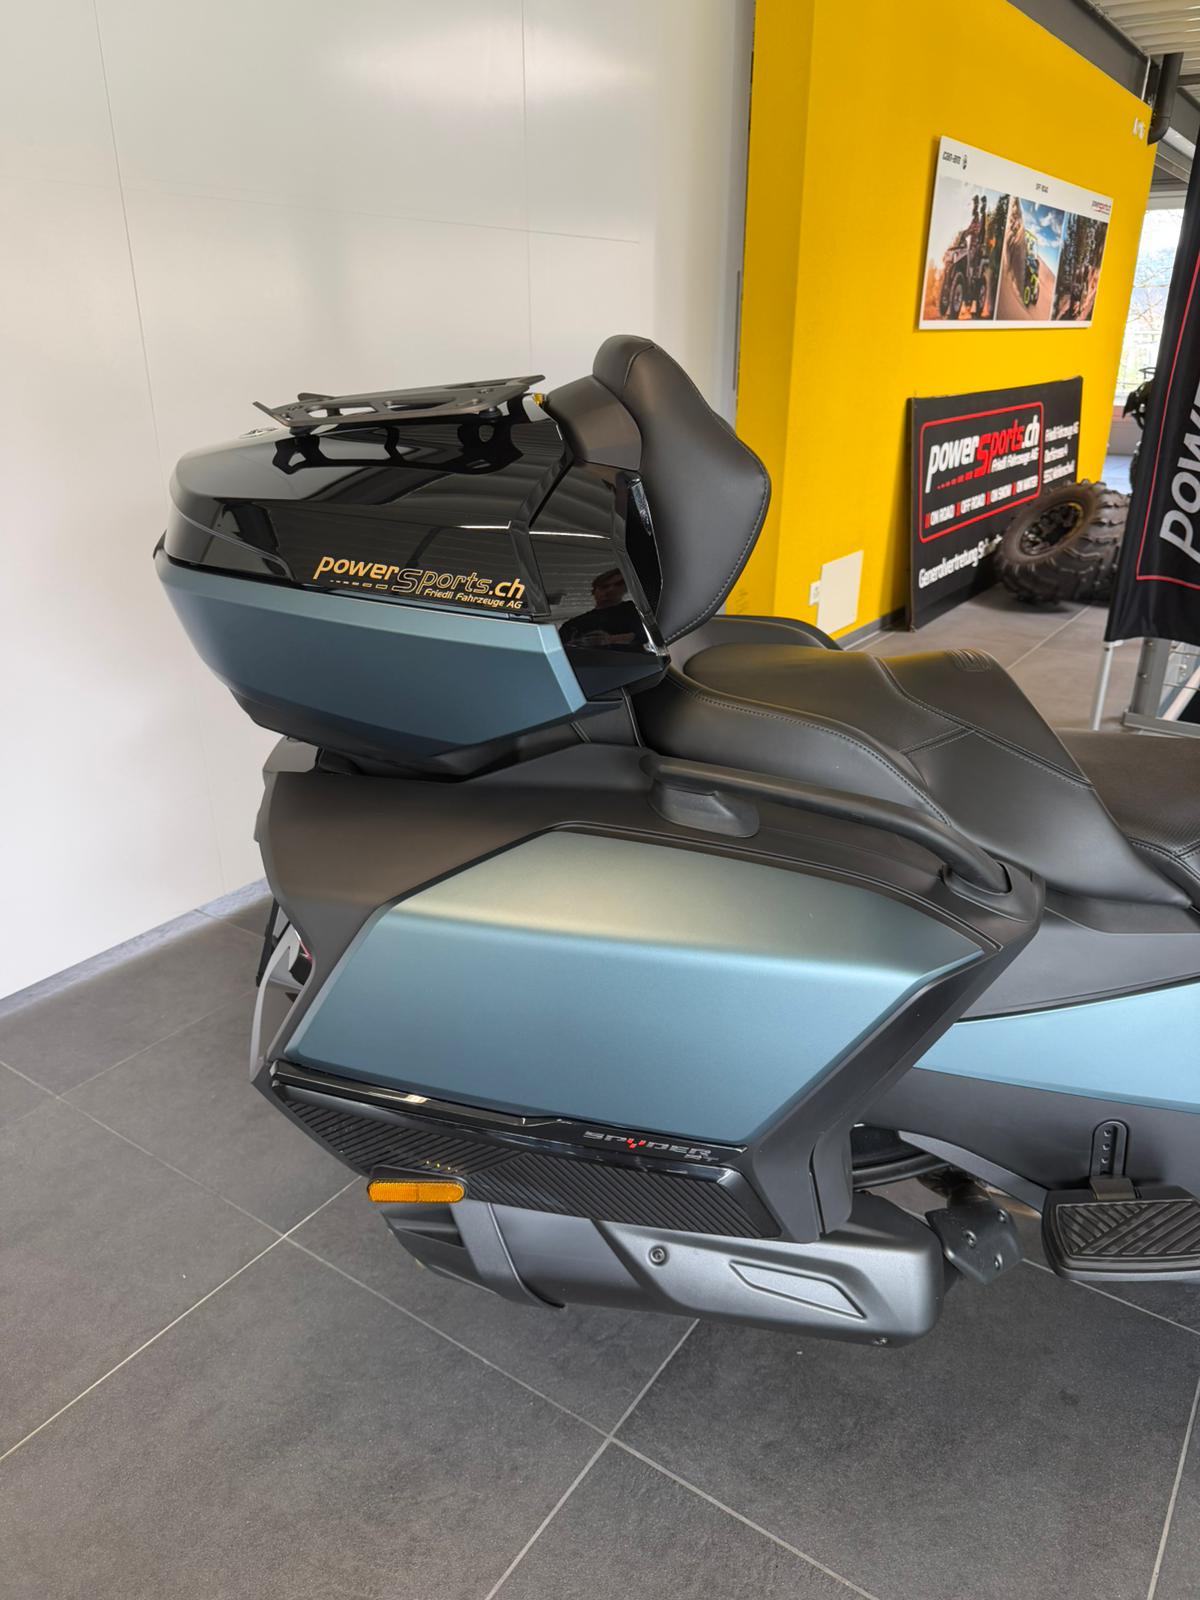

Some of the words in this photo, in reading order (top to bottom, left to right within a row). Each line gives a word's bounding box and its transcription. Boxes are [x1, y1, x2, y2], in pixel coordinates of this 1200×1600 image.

[456, 592, 504, 608] Fahrzeuge
[506, 601, 523, 609] AG
[583, 1130, 711, 1157] SPYDER
